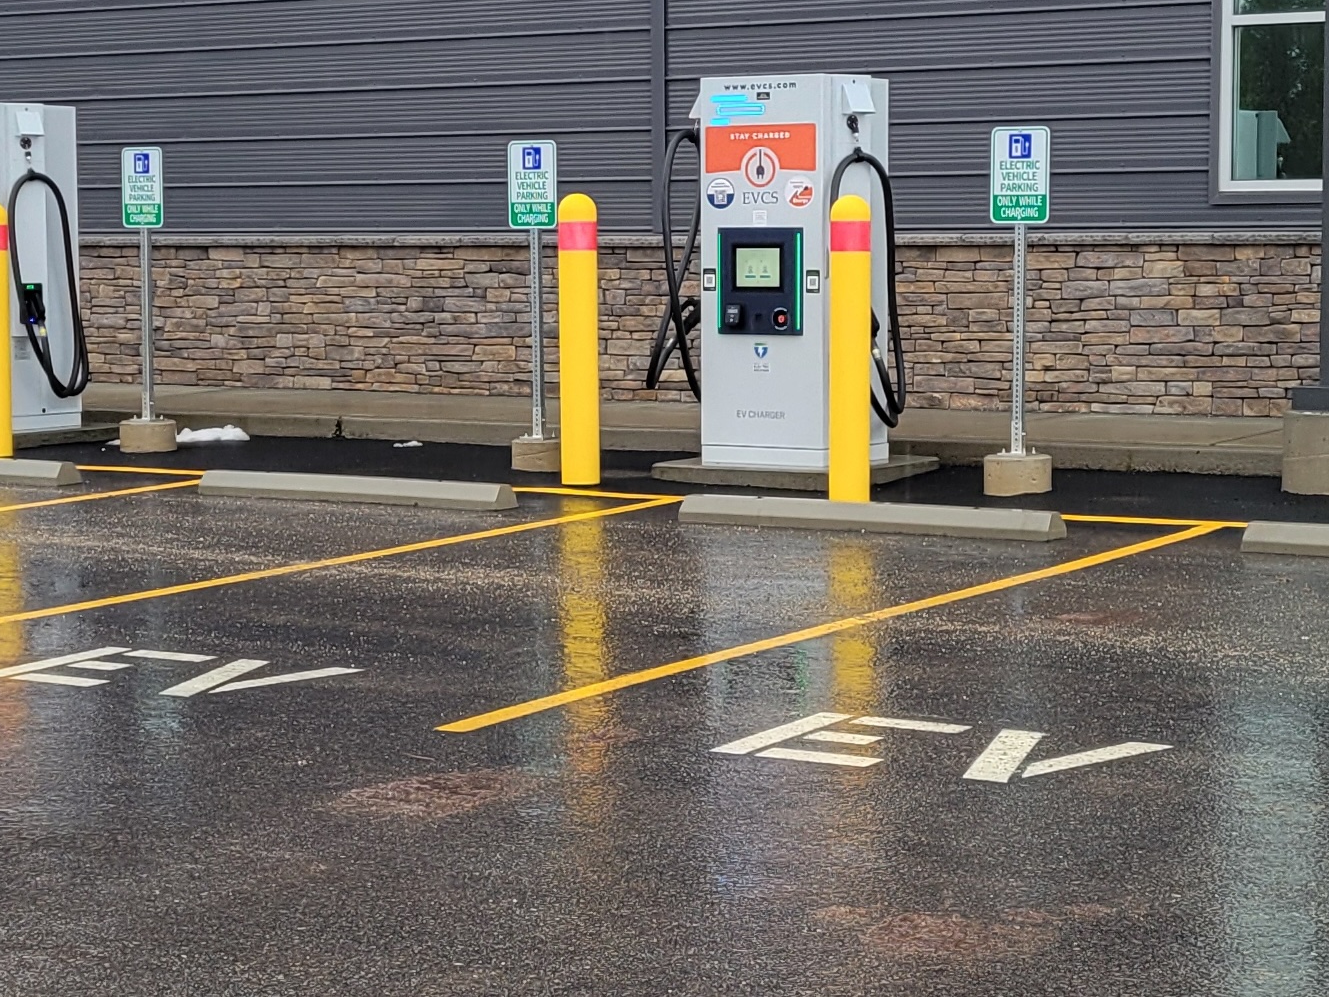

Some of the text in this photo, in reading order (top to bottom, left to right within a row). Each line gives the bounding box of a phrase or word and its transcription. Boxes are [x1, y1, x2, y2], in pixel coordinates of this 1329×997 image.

[724, 81, 797, 91] www.evcs.com
[730, 131, 790, 140] STAY CHARGED
[999, 160, 1040, 170] ELECTRIC
[515, 171, 549, 181] ELECTRIC
[1001, 171, 1038, 181] VEHICLE
[517, 181, 547, 190] VEHICLE
[1000, 182, 1039, 192] PARKING
[516, 191, 548, 200] PARKING
[742, 190, 779, 205] EVCS
[997, 196, 1043, 206] ONLY WHILE
[1000, 207, 1039, 218] CHARGING
[736, 409, 747, 418] EV
[708, 711, 1174, 784] EV
